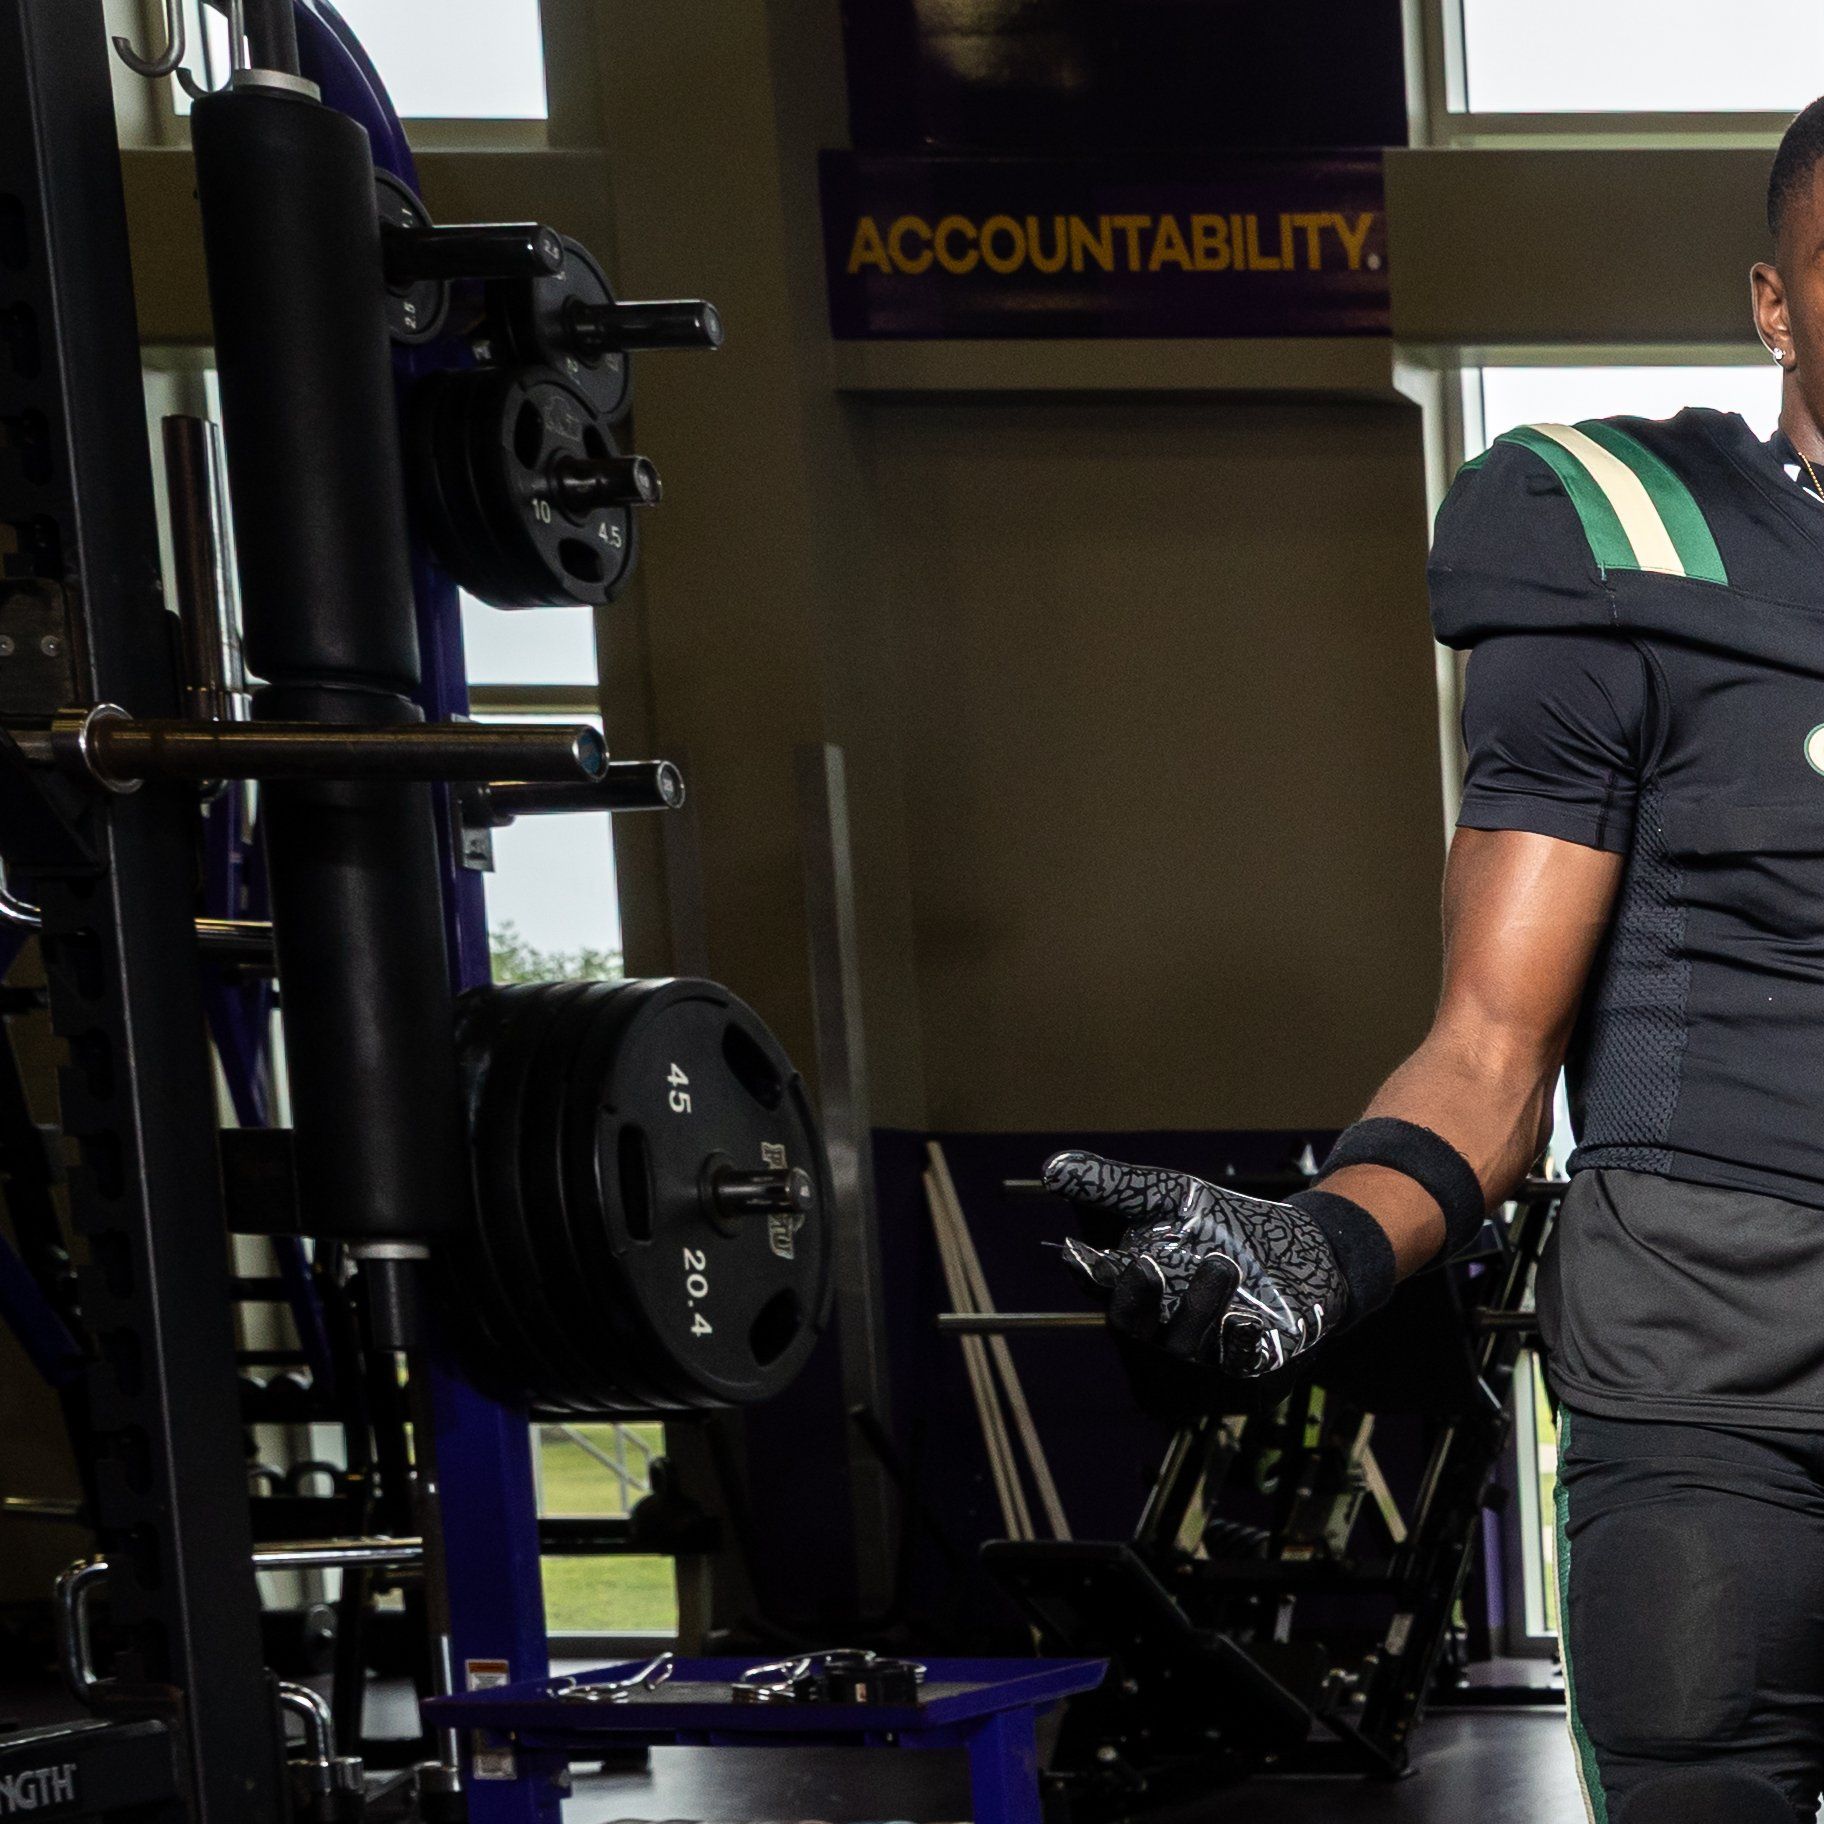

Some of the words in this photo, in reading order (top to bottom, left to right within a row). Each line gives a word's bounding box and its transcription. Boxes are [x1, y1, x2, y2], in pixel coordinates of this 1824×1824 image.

[846, 211, 1382, 275] ACCOUNTABILITY.
[531, 498, 552, 525] 10
[598, 522, 623, 549] 4.5
[666, 1062, 692, 1114] 45
[682, 1246, 714, 1339] 20.4
